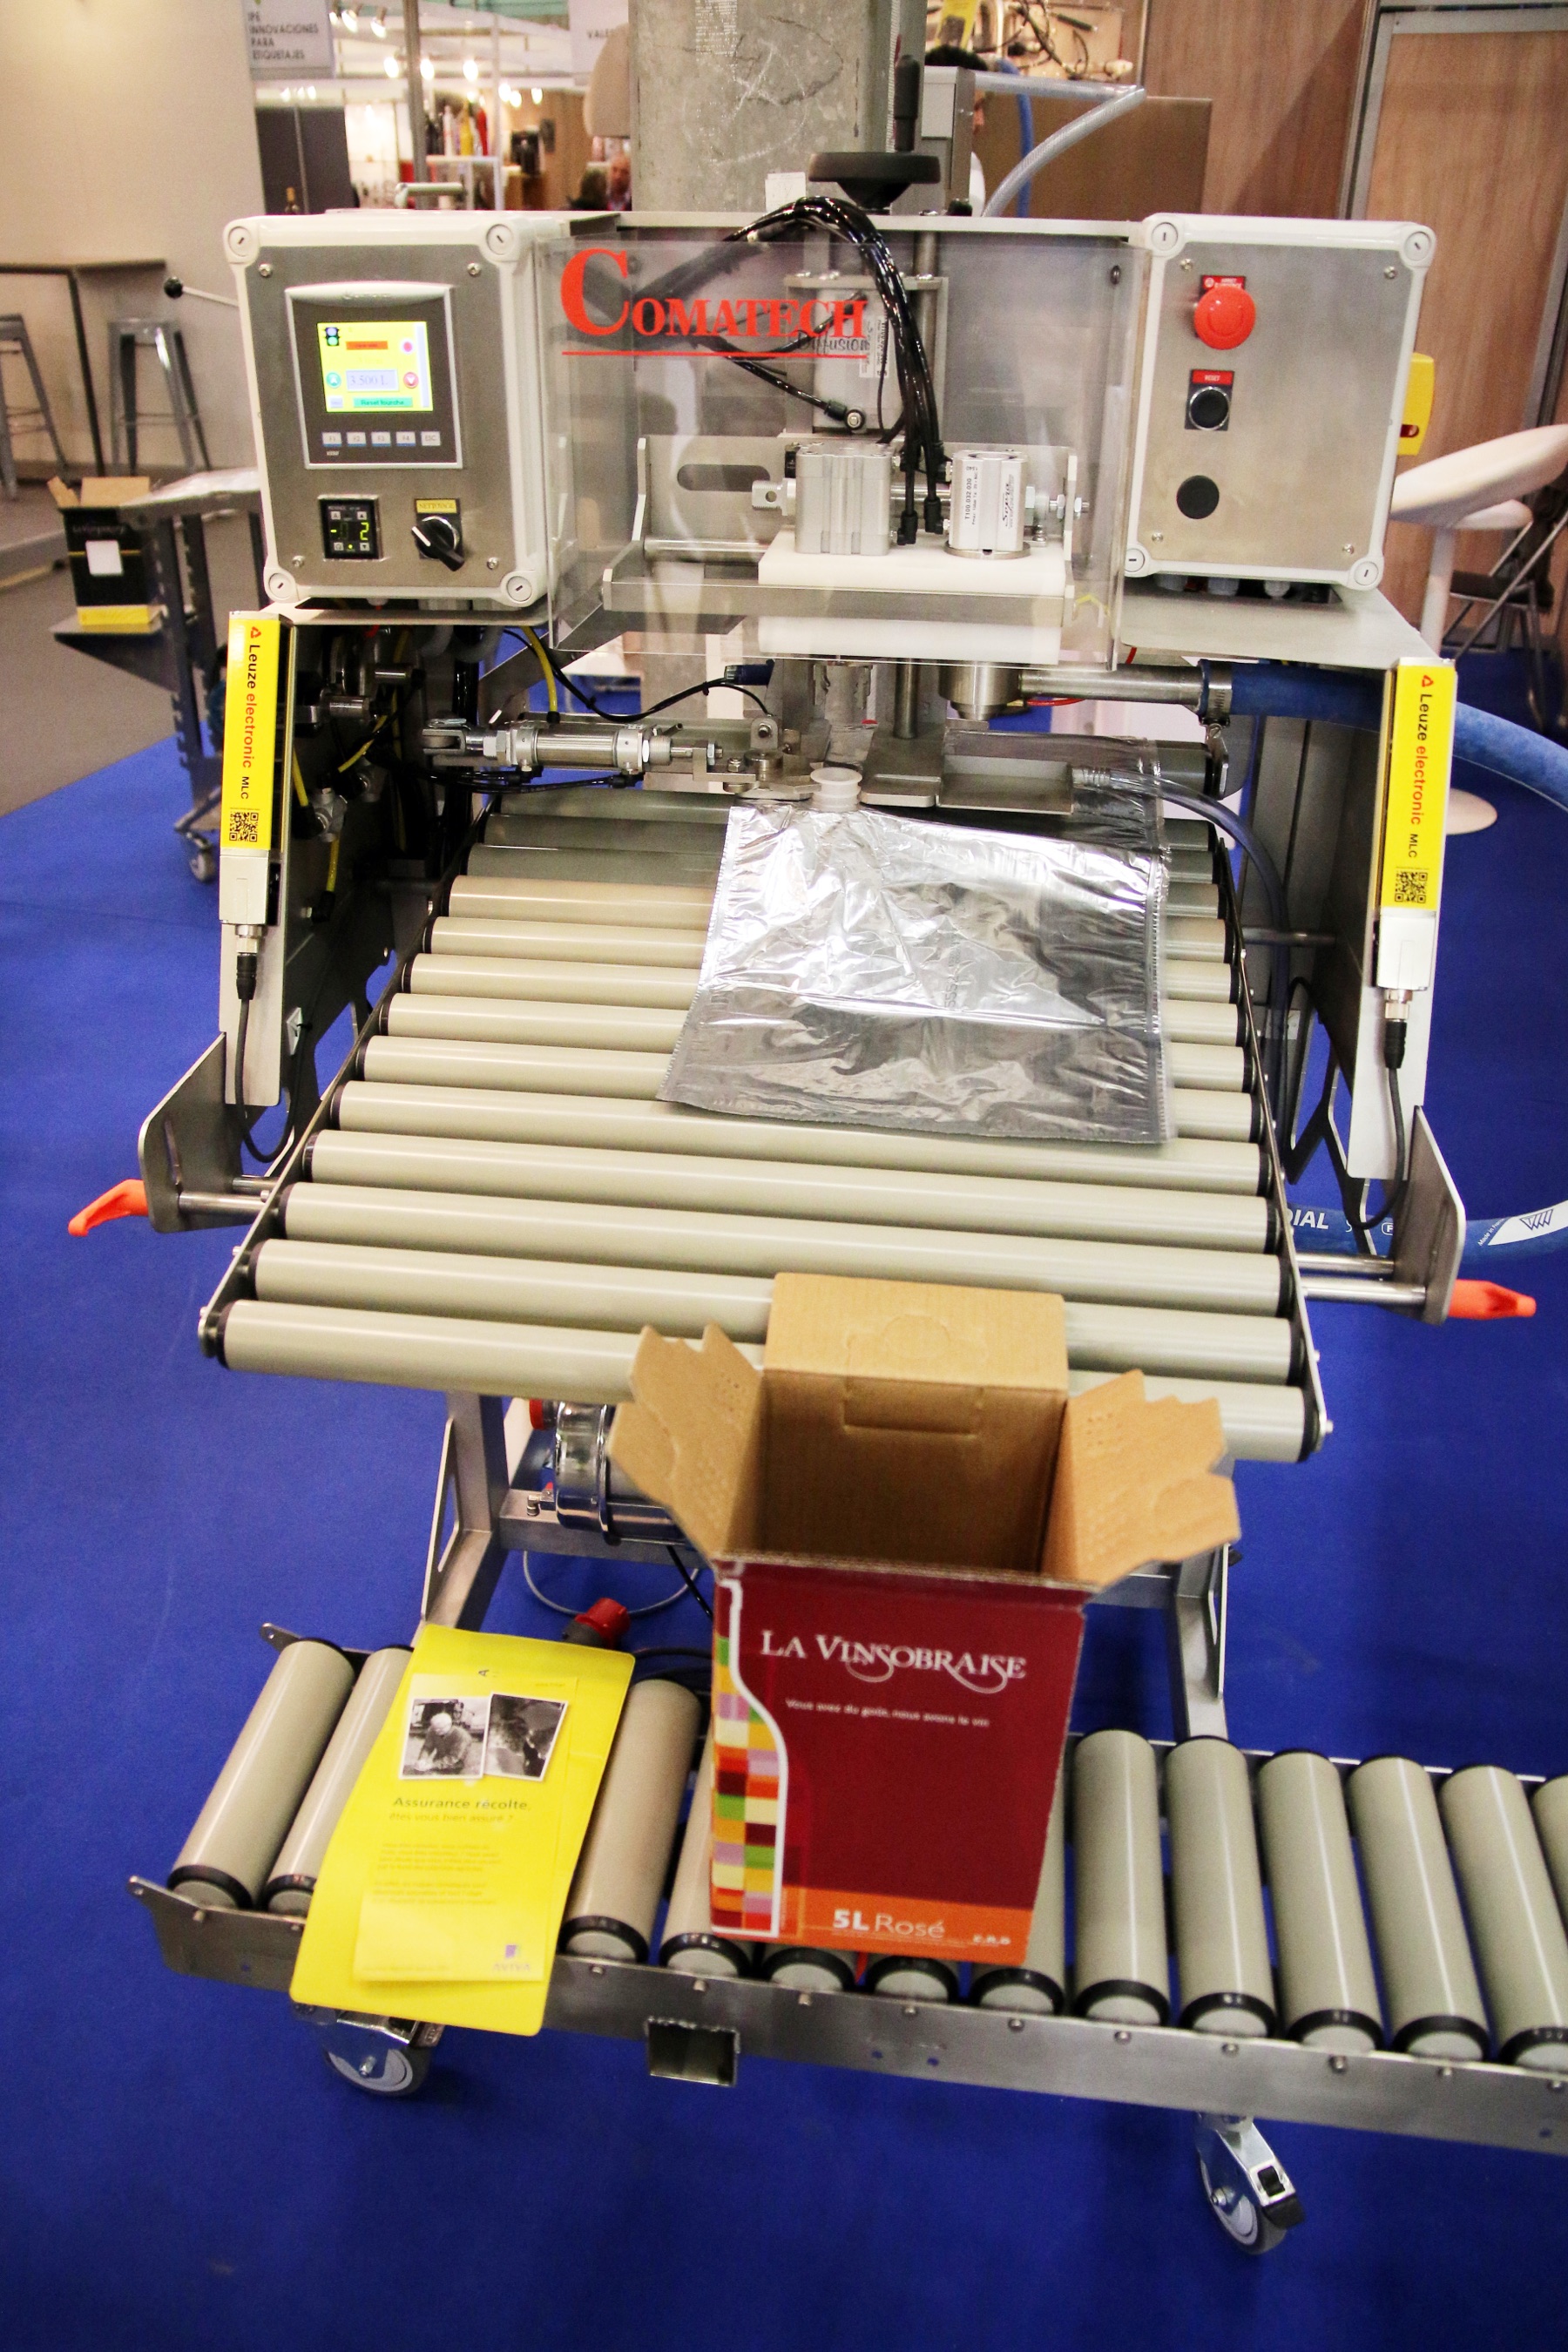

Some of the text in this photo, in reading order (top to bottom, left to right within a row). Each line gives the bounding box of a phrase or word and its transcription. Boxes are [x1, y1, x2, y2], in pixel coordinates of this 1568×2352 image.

[251, 37, 274, 46] PARA
[560, 247, 868, 338] COMATECH
[247, 644, 260, 689] Leuze
[1418, 693, 1433, 741] Leuze
[242, 693, 257, 768] electronic
[240, 776, 249, 800] MLC
[1410, 746, 1428, 826] electronic
[1408, 834, 1419, 858] MLC
[1477, 1232, 1490, 1247] Made
[760, 1629, 1027, 1693] LA VINSOBRAISE
[391, 1797, 470, 1809] Assurance
[415, 1813, 440, 1821] vous
[443, 1812, 466, 1822] bien
[832, 1909, 946, 1938] 5L Rosé
[493, 1963, 531, 1973] AVIVA
